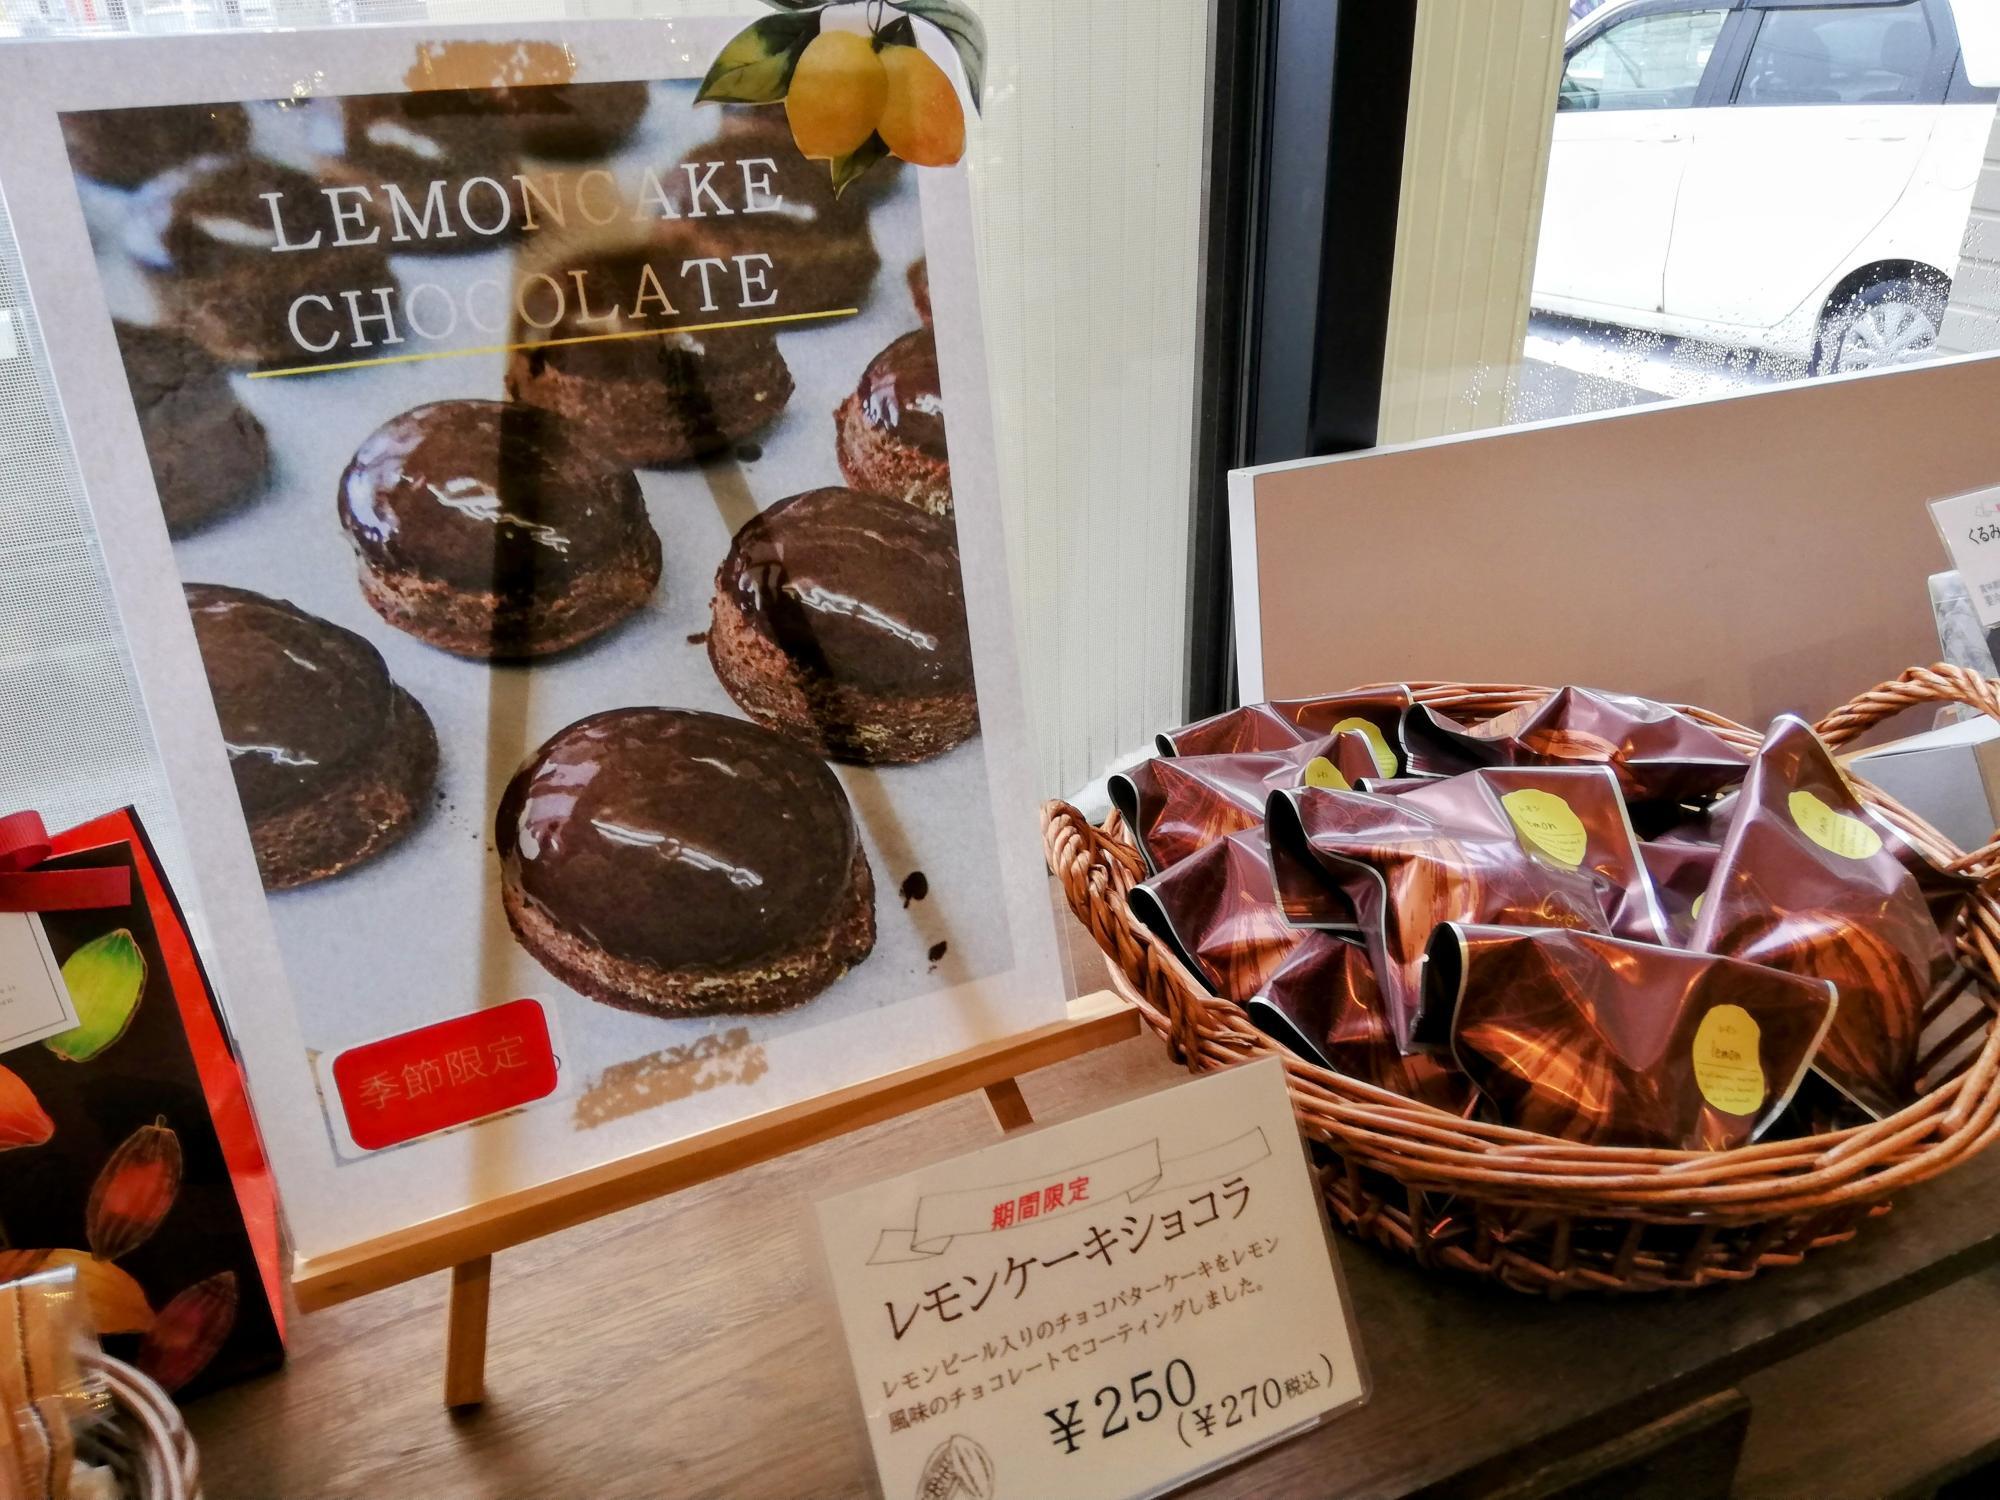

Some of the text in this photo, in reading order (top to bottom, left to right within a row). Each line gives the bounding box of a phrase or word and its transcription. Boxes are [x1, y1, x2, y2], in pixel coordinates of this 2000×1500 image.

[259, 158, 784, 254] LEMONCAKE
[287, 253, 780, 353] CHOCOLATE
[360, 1035, 528, 1110] 季節限定
[991, 1176, 1090, 1232] 期間限定
[884, 1176, 1250, 1341] レモンケーキショコラ
